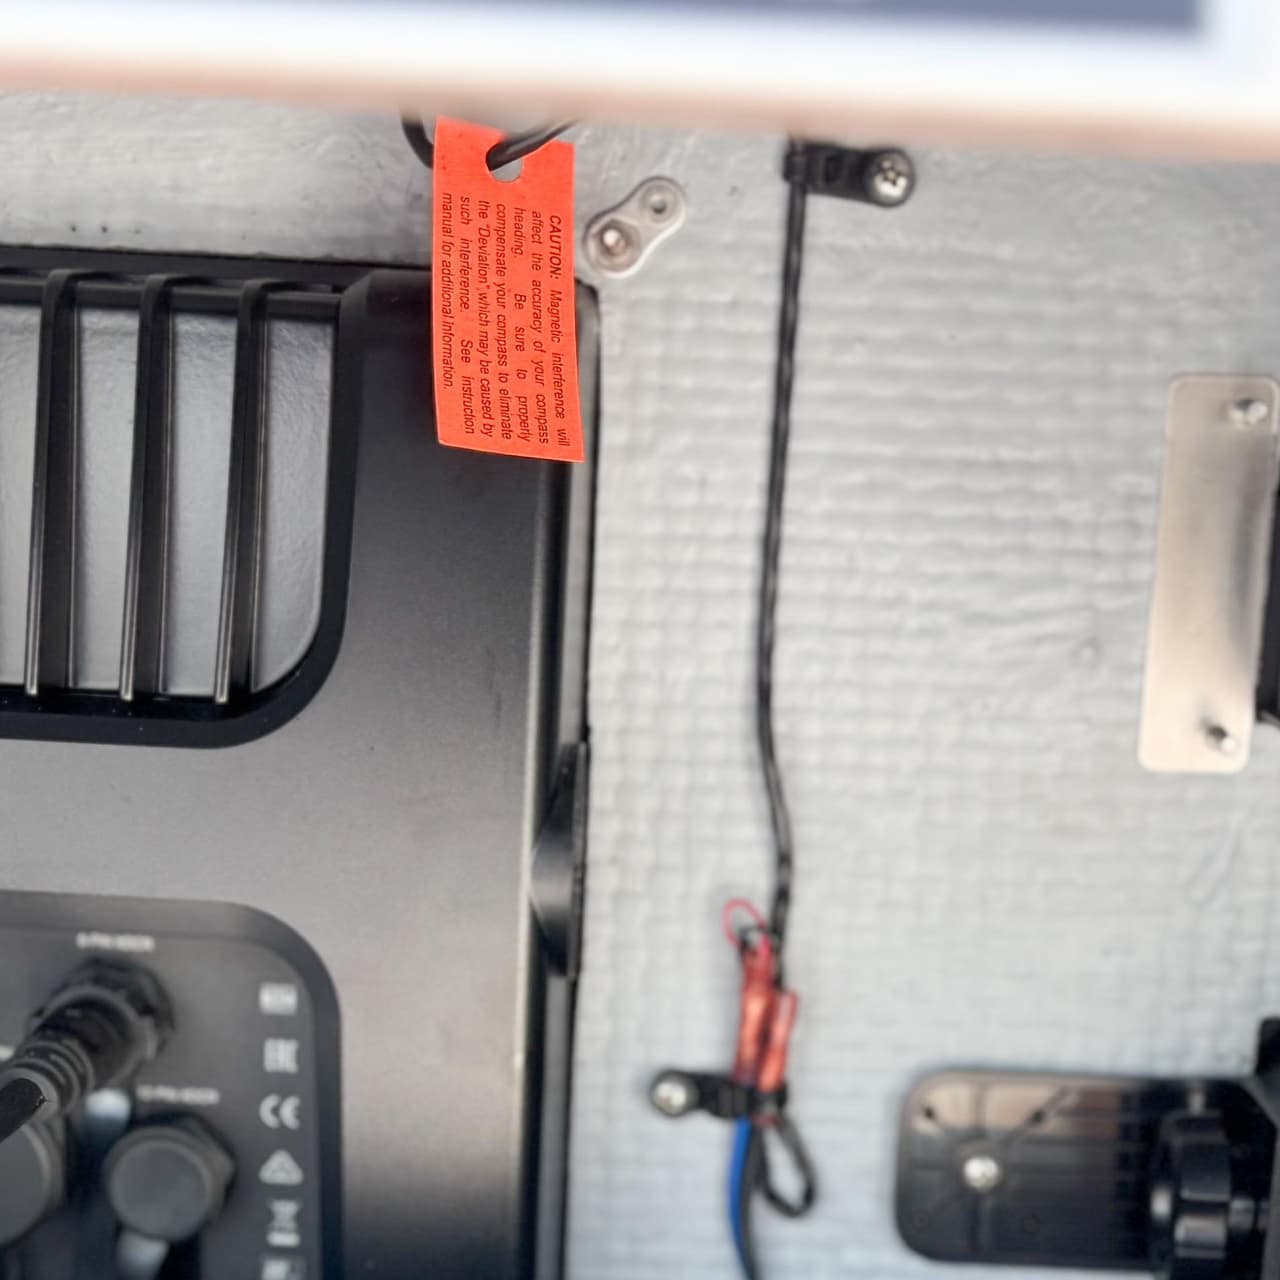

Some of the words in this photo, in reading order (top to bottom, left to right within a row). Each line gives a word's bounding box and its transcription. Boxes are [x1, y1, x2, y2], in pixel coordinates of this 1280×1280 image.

[442, 192, 454, 238] manual
[461, 196, 472, 225] such
[478, 200, 490, 219] the
[494, 203, 507, 277] compensate
[511, 207, 527, 258] heading.
[531, 210, 544, 245] affect
[442, 240, 454, 258] for
[531, 253, 544, 272] the
[549, 215, 562, 279] CAUTION:
[442, 260, 454, 319] additional
[460, 238, 472, 312] interference.
[478, 292, 490, 327] which
[493, 281, 507, 309] your
[514, 293, 527, 310] Be
[529, 279, 543, 334] accuracy
[547, 289, 563, 344] Magnetic
[442, 320, 456, 390] information.
[461, 339, 473, 364] See
[476, 329, 490, 357] may
[496, 313, 508, 367] compass
[515, 326, 525, 352] sure
[533, 340, 546, 353] of
[480, 359, 493, 375] be
[498, 372, 509, 384] to
[516, 368, 528, 380] to
[531, 359, 545, 387] your
[480, 378, 495, 421] caused
[552, 352, 566, 419] interference
[461, 376, 476, 435] instruction
[499, 388, 514, 440] eliminate
[515, 395, 534, 442] properly
[534, 393, 549, 444] compass
[480, 422, 495, 437] by
[557, 428, 570, 447] will
